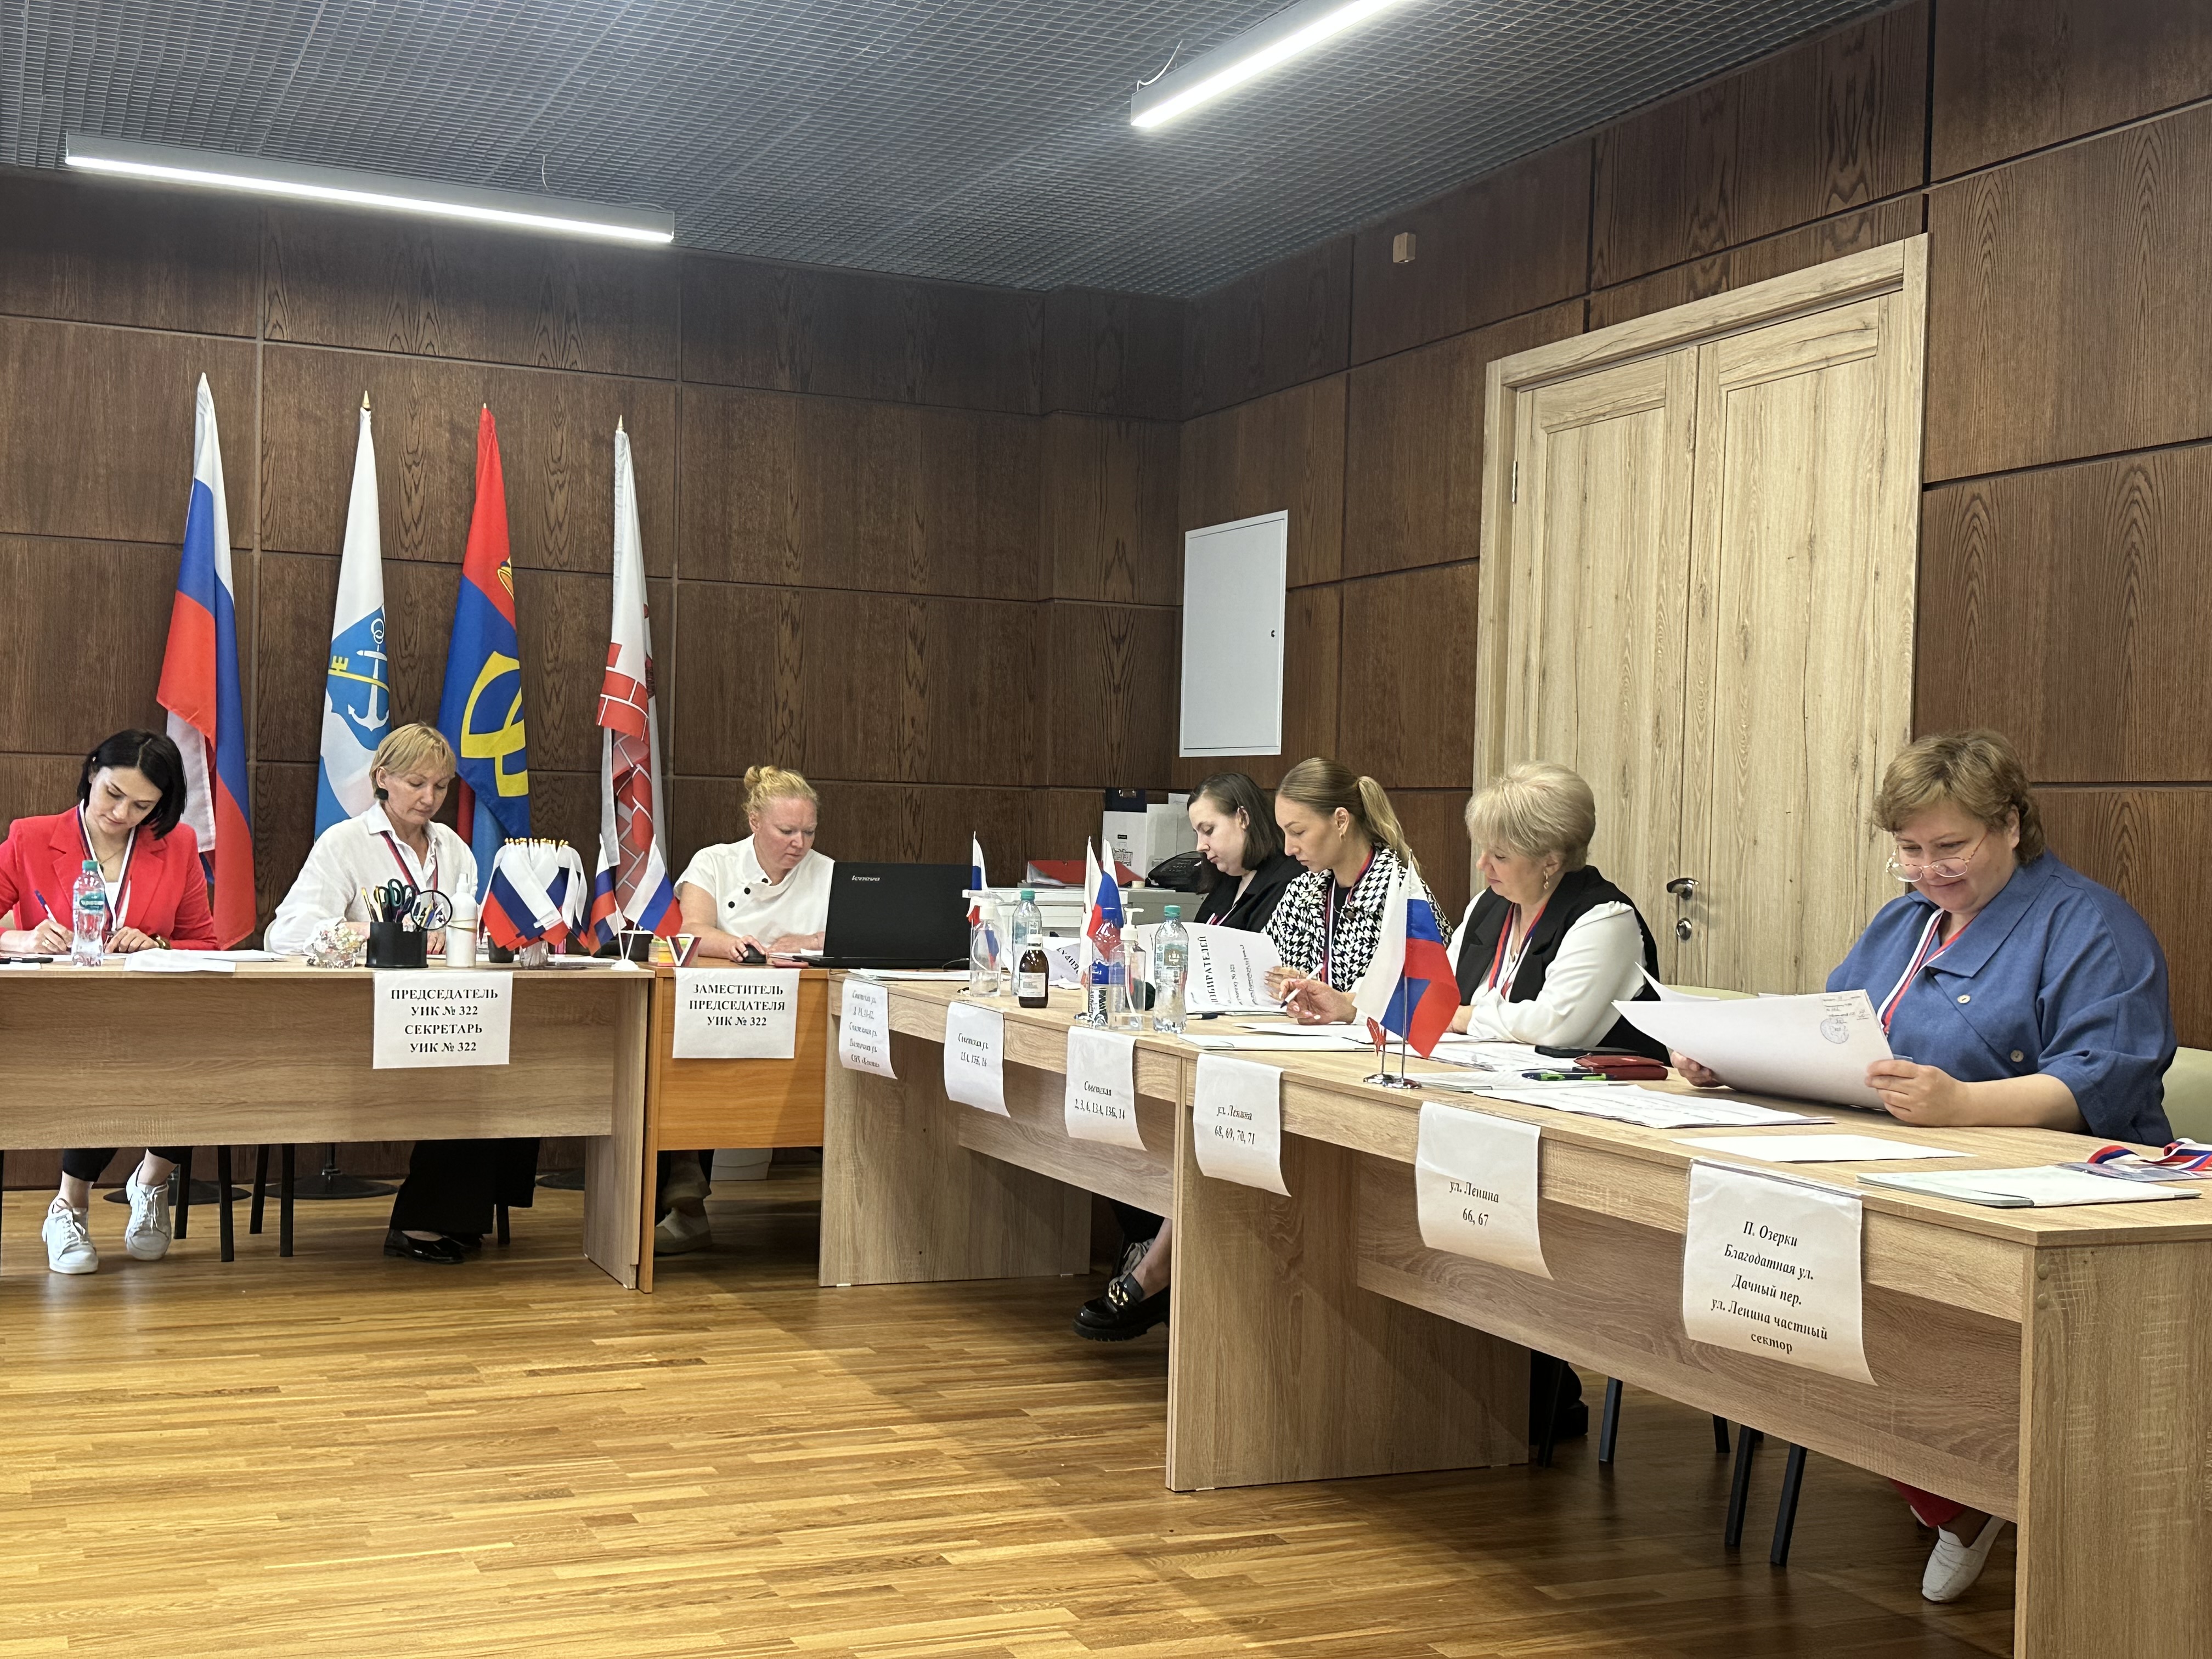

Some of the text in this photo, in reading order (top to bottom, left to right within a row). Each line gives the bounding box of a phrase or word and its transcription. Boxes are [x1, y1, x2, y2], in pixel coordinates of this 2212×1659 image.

[391, 989, 498, 1001] ПРЕДСЕДАТЕЛЬ
[693, 984, 783, 995] ЗАМЕСТИТЕЛЬ
[411, 1006, 478, 1015] УИК № 322
[690, 1000, 785, 1011] ПРЕДСЕДАТЕЛЯ
[405, 1024, 482, 1034] СЕКРЕТАРЬ
[707, 1017, 766, 1026] УИК № 322
[410, 1042, 476, 1052] УИК № 322
[1226, 1127, 1234, 1141] 69,
[1237, 1129, 1245, 1144] 70,
[1248, 1132, 1255, 1144] 71
[1449, 1181, 1499, 1203] ул. Ленина
[1463, 1208, 1489, 1226] 66, 67
[1743, 1221, 1798, 1247] П. Озерки
[1724, 1244, 1814, 1280] Благодатная ул.
[1731, 1274, 1802, 1307] Дачный пер.
[1711, 1298, 1828, 1340] ул. Ленина частный
[1751, 1333, 1793, 1355] сектор
